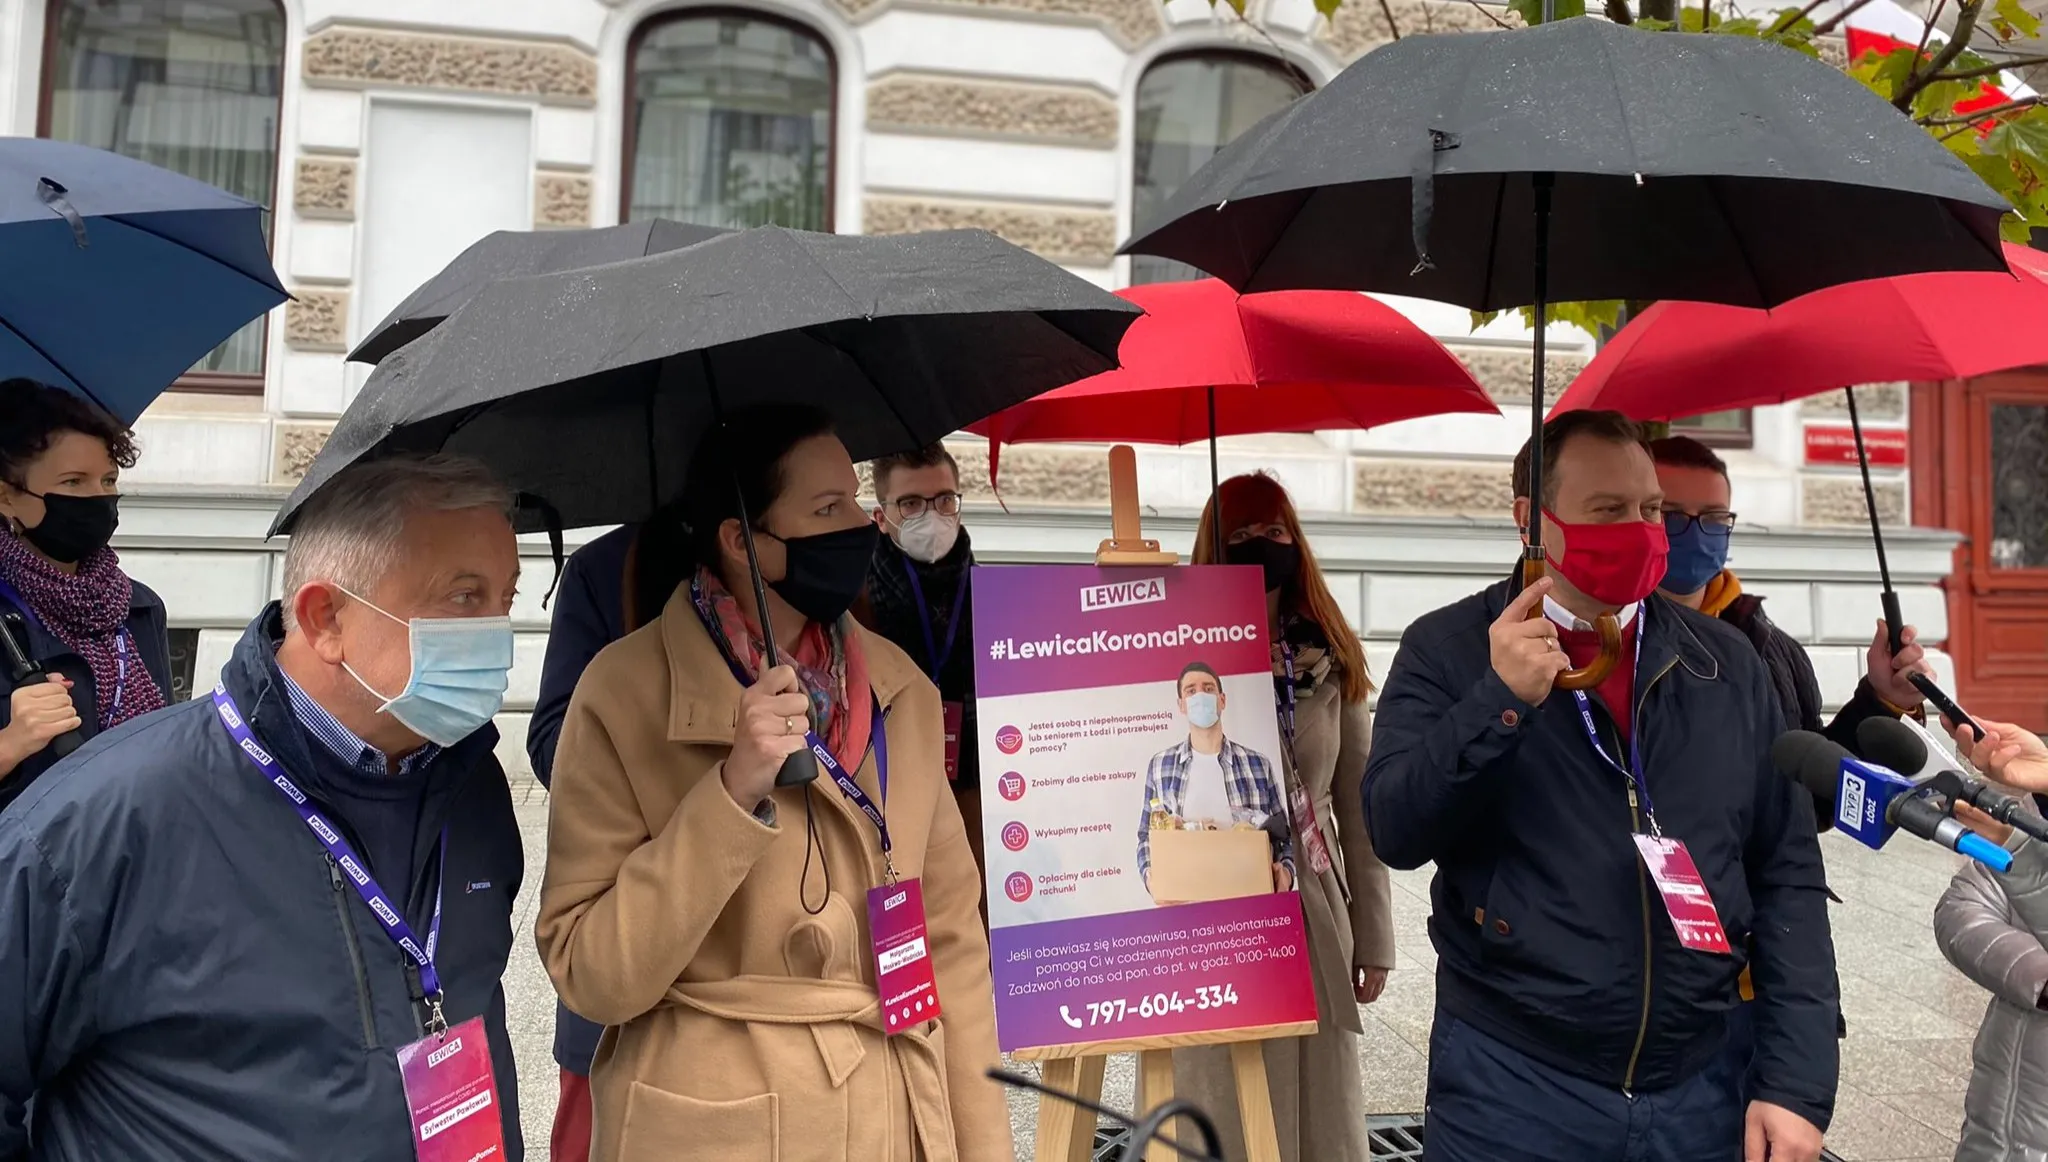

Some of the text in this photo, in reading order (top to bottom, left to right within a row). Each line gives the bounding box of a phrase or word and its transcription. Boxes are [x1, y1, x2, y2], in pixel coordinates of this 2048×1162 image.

[1086, 580, 1162, 607] LEWICA
[990, 622, 1258, 661] #LewicaKoronaPomoc
[1028, 722, 1054, 731] Jesteś
[1056, 718, 1081, 729] osobą
[1089, 711, 1173, 725] niepełnosprawnością
[1028, 733, 1042, 742] lub
[1044, 731, 1082, 741] seniorem
[1090, 726, 1112, 736] Łodzi
[1117, 723, 1169, 736] potrzebujesz
[243, 739, 271, 764] LEWICA
[815, 745, 836, 768] LEWICA
[1029, 742, 1067, 755] pomocy?
[275, 777, 304, 803] LEWICA
[839, 777, 861, 798] LEWICA
[1031, 770, 1137, 788] Zrobimy dla ciebie zakupy
[864, 805, 883, 827] LEWICA
[309, 816, 337, 843] LEWICA
[1034, 823, 1112, 839] Wykupimy receptę
[341, 856, 368, 885] LEWICA
[1038, 866, 1122, 885] Opłacimy dla ciebie
[885, 892, 905, 909] LEWICA
[1039, 884, 1077, 896] rachunki
[371, 897, 399, 925] LEWICA
[402, 938, 427, 965] LEWICA
[1006, 915, 1291, 963] Jeśli obawiasz się koronawirusa, nasi wolontariusze
[1035, 934, 1268, 978] pomogą Ci w codziennych czynnościach.
[1008, 944, 1296, 996] Zadzwoń do nas od pon. do pt. w godz. 10:00-14:00
[1086, 982, 1239, 1027] 797-604-334
[429, 1040, 461, 1065] LEWICA
[424, 1113, 456, 1135] Sylwester
[456, 1092, 489, 1117] Pawłowski
